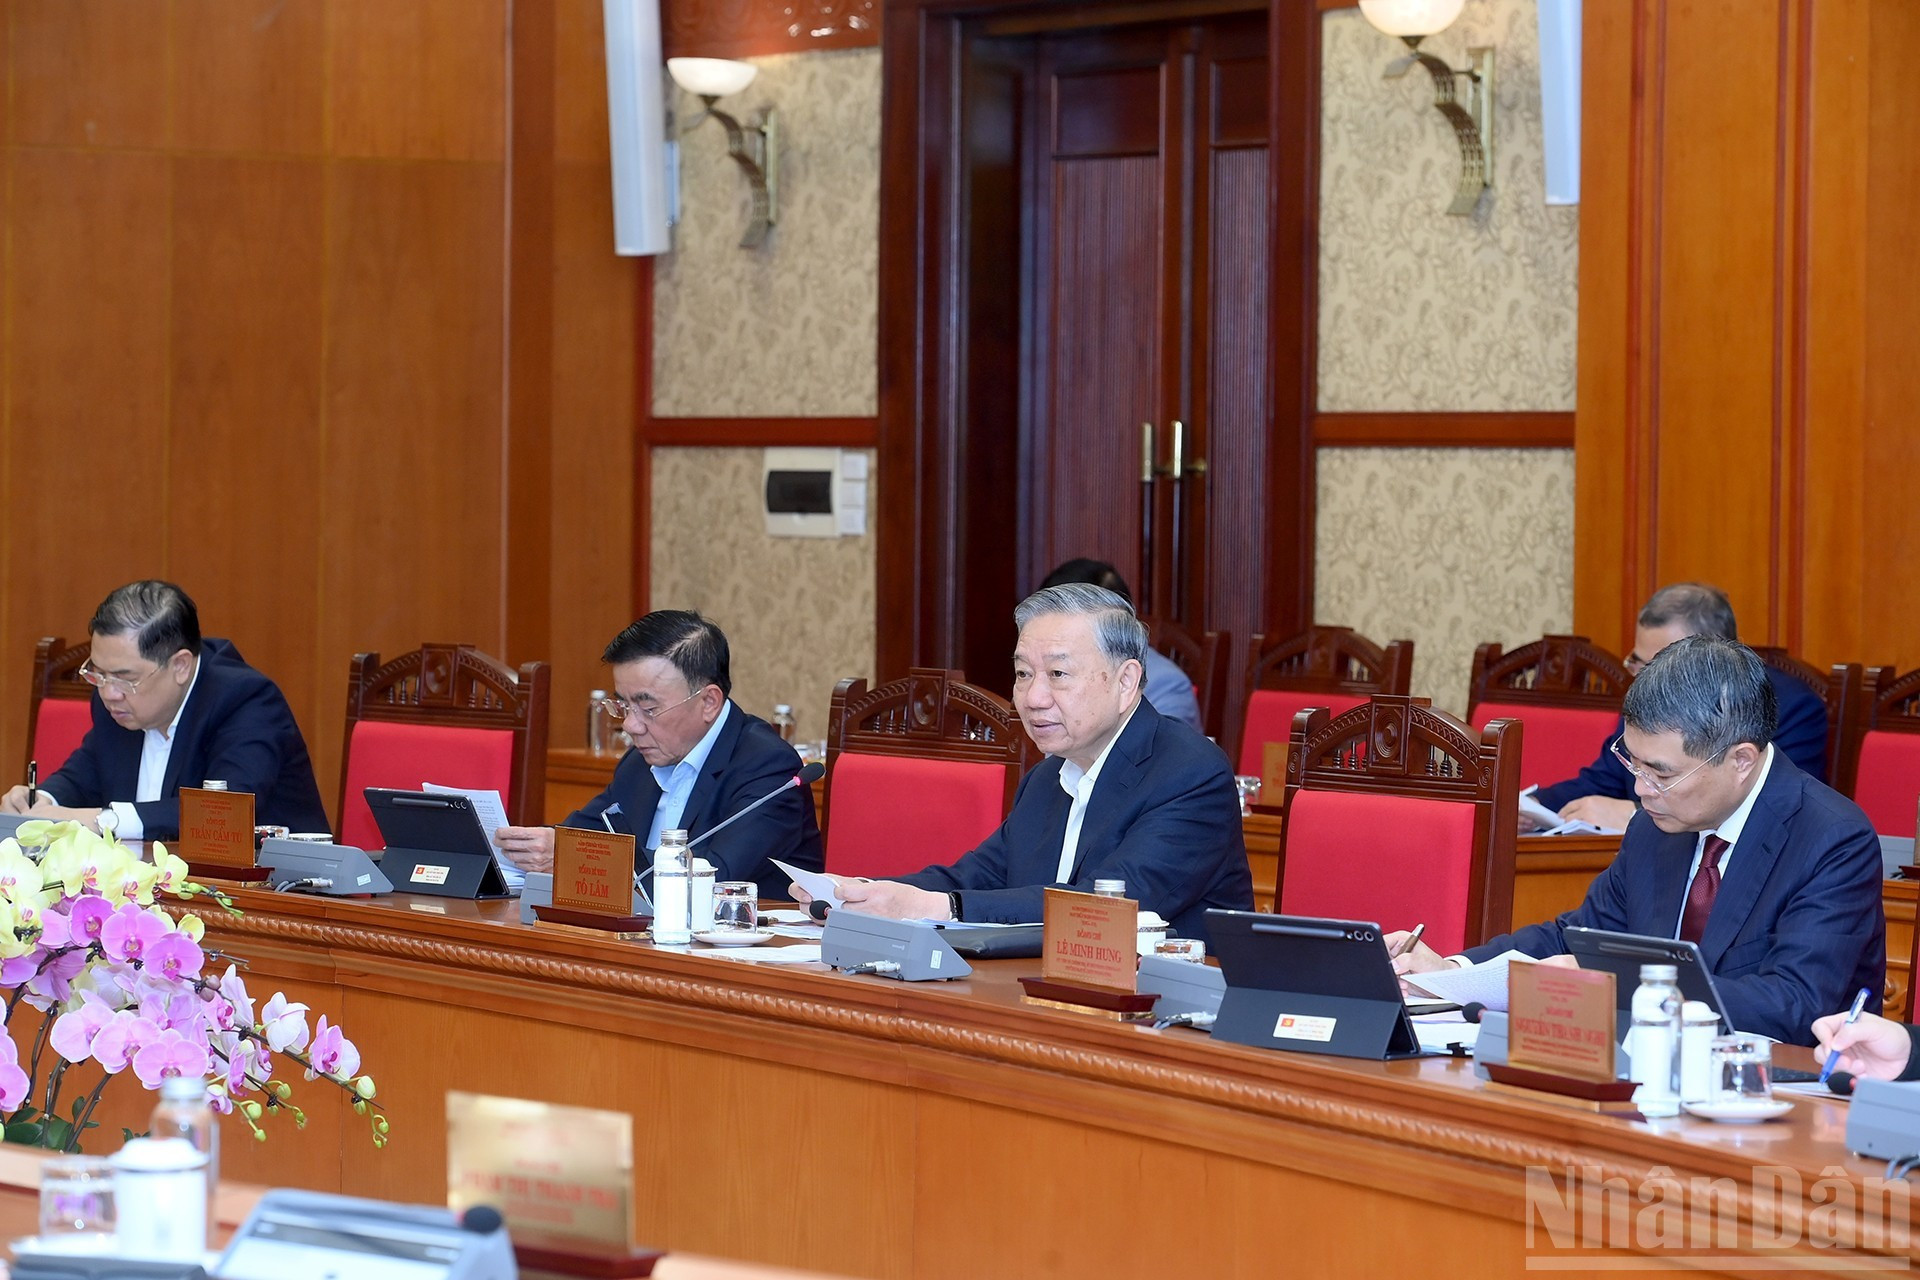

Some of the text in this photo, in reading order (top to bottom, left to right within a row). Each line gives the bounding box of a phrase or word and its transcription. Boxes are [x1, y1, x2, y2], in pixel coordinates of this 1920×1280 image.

[575, 878, 609, 898] TÔ LÂM
[1056, 939, 1068, 956] LÊ
[1069, 942, 1093, 958] MINH
